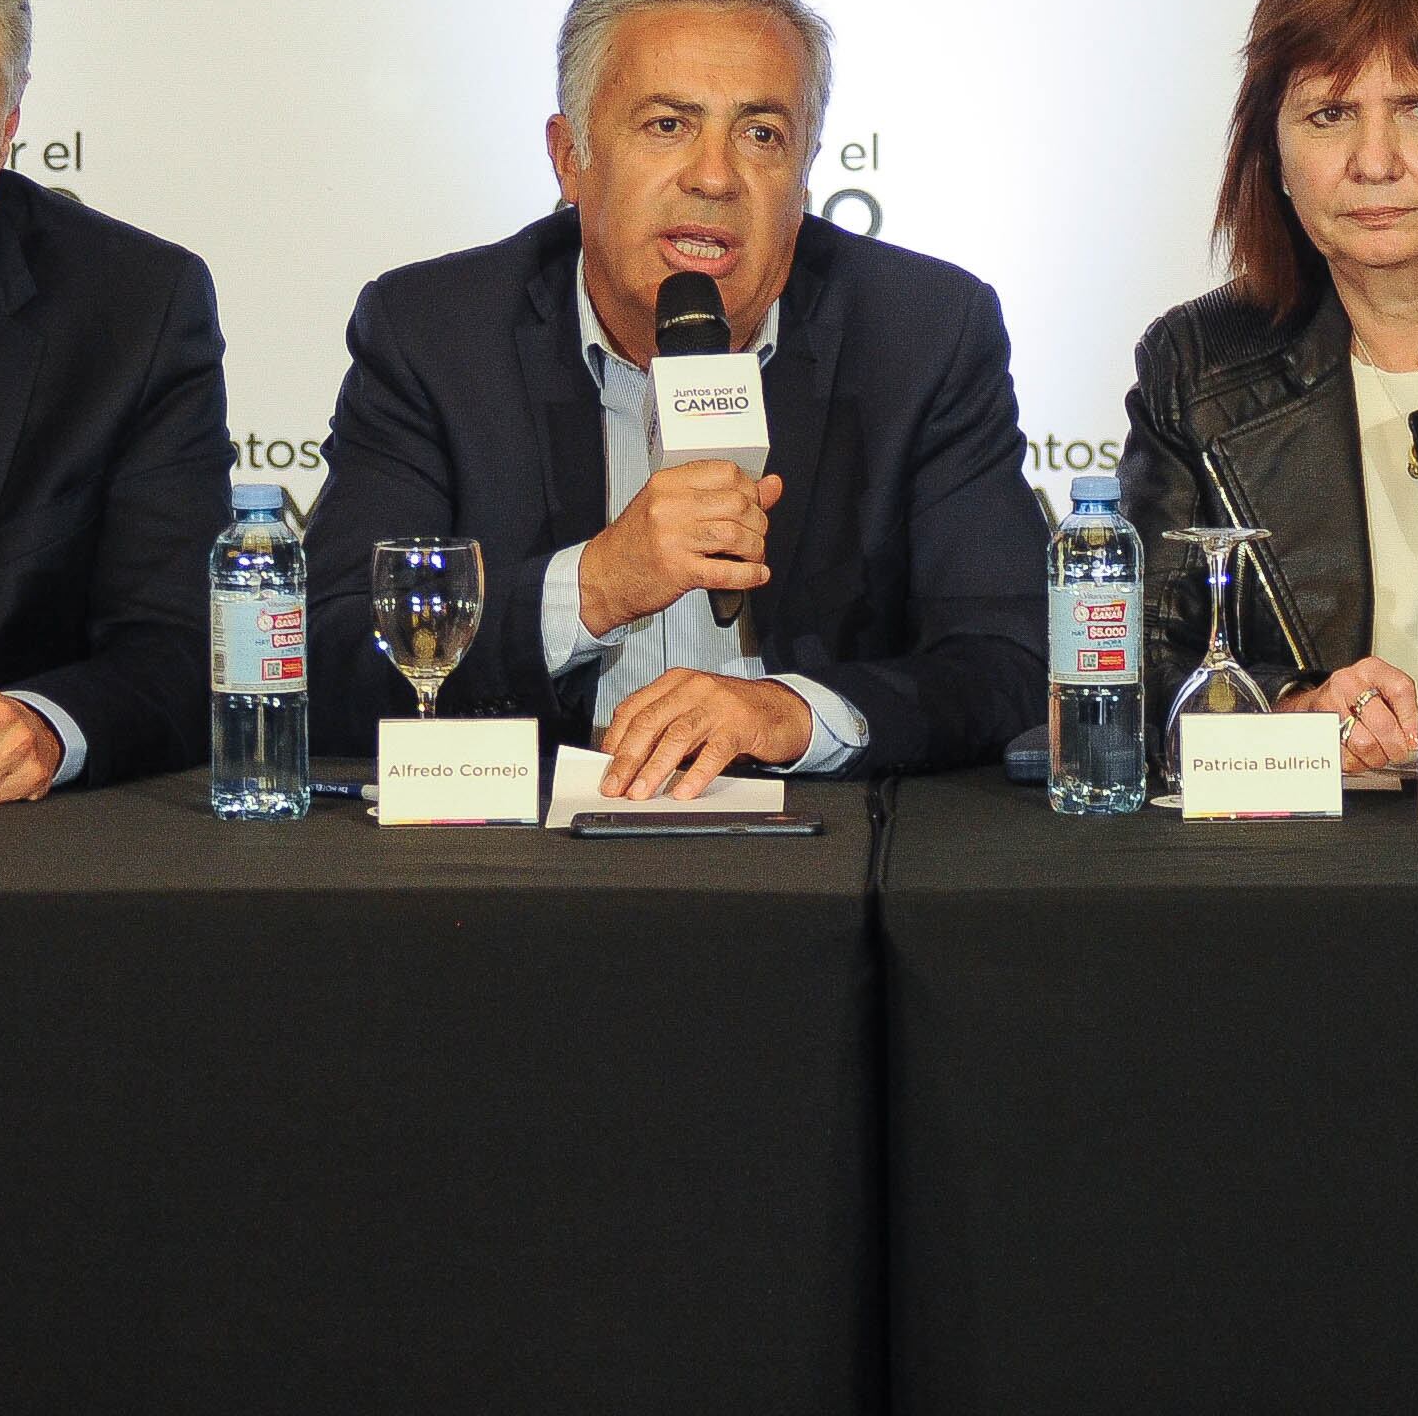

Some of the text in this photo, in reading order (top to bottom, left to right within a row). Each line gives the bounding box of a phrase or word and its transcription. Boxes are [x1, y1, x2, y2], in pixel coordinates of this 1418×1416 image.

[42, 130, 81, 171] el
[840, 131, 879, 172] el
[672, 384, 748, 399] Juntos por el
[673, 395, 750, 413] CAMBIO
[1088, 625, 1127, 640] $5.000
[387, 762, 529, 780] Alfredo Cornejo
[1192, 755, 1331, 772] Patricia Bullrich
